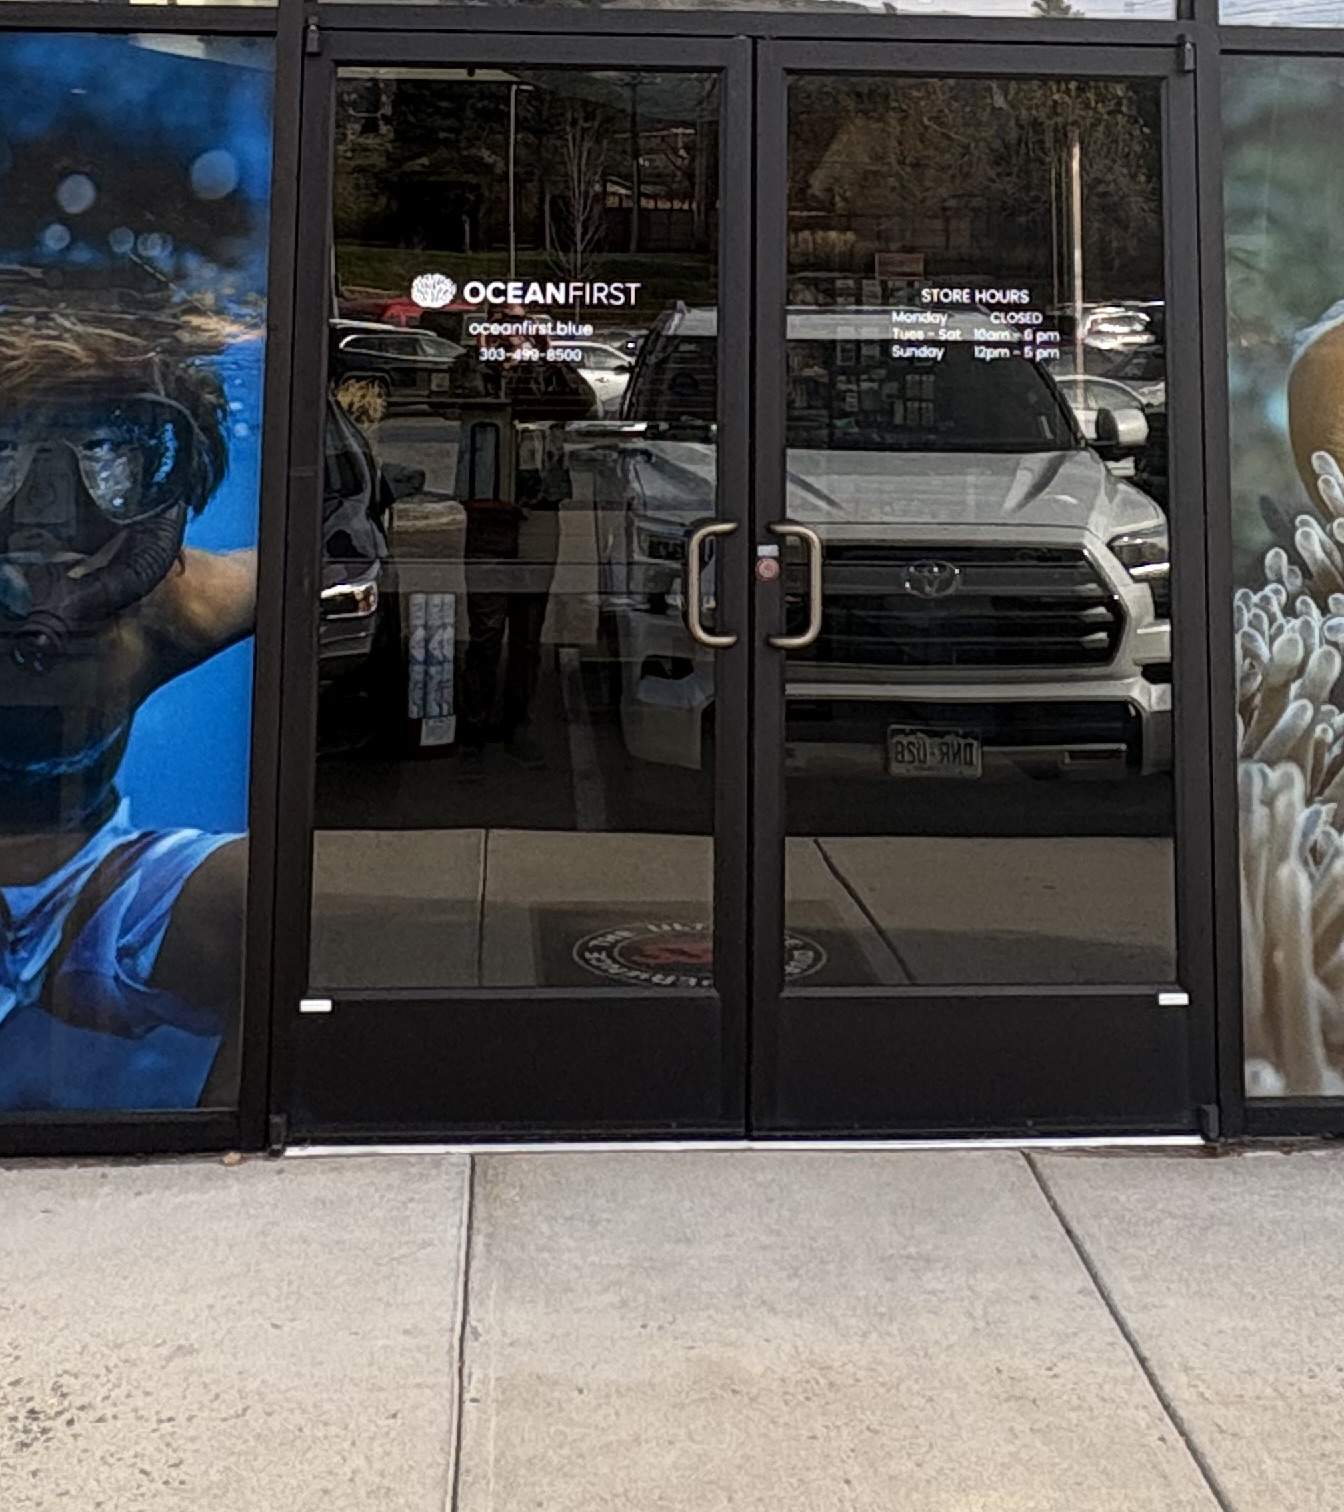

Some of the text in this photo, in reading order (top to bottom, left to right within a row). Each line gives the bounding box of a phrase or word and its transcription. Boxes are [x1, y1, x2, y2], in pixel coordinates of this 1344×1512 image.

[462, 280, 642, 306] OCEANFIRST
[921, 288, 1029, 303] STORE HOURS
[891, 310, 1043, 327] Monday CLOSED
[468, 320, 595, 337] oceanfirst.blue
[891, 328, 925, 341] Tues
[938, 328, 962, 341] Sat
[1036, 330, 1060, 345] pm
[892, 346, 945, 361] Sunday
[1036, 348, 1060, 361] pm
